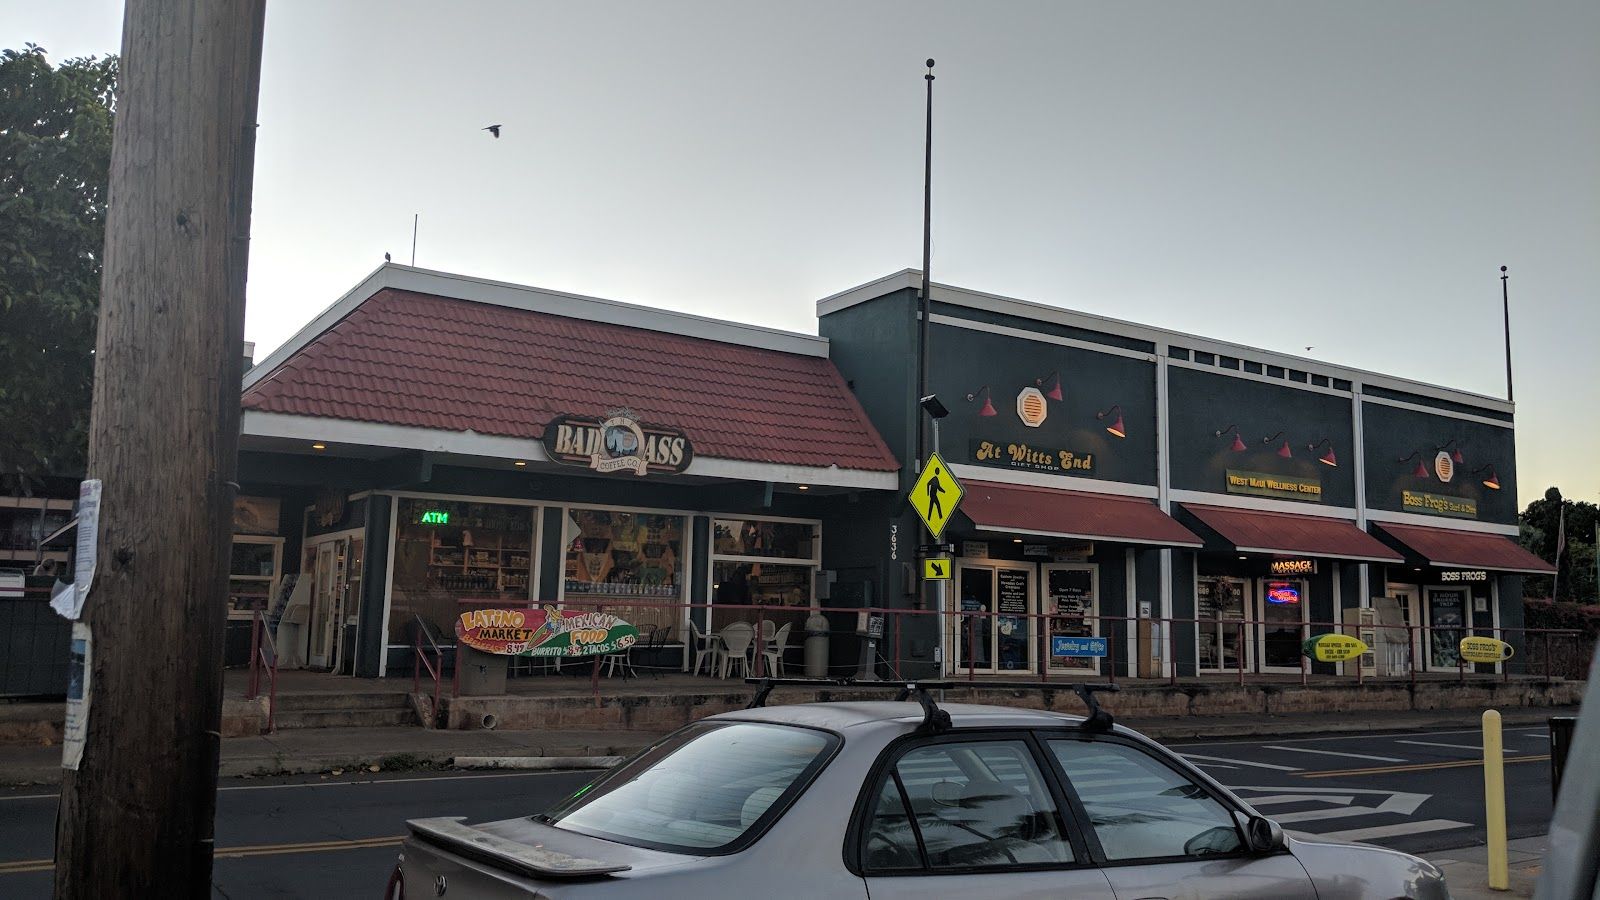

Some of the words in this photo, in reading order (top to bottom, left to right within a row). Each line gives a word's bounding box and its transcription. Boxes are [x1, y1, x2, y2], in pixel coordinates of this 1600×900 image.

[554, 424, 601, 456] BAD
[642, 435, 685, 466] ASS
[976, 441, 1001, 460] At
[1008, 444, 1052, 465] Witts
[1059, 450, 1092, 470] End
[600, 460, 624, 470] COFFEE
[1229, 475, 1248, 486] WEST
[1249, 477, 1266, 488] MAUI
[1267, 480, 1297, 491] WELLNESS
[1299, 484, 1321, 494] CENTER
[1402, 490, 1423, 507] Boss
[1424, 494, 1448, 513] Frog's
[421, 511, 448, 524] ATM
[1270, 560, 1313, 571] MASSAGE
[1441, 571, 1460, 581] BOSS
[1461, 571, 1487, 581] FROG'S
[564, 612, 619, 632] MEXICAN
[479, 628, 533, 641] MARKET
[570, 628, 608, 645] FOOD
[531, 646, 561, 656] BURRITO
[588, 643, 610, 653] TACOS
[1055, 640, 1080, 653] Jewelry
[1080, 642, 1089, 651] and
[1466, 642, 1478, 650] BOSS
